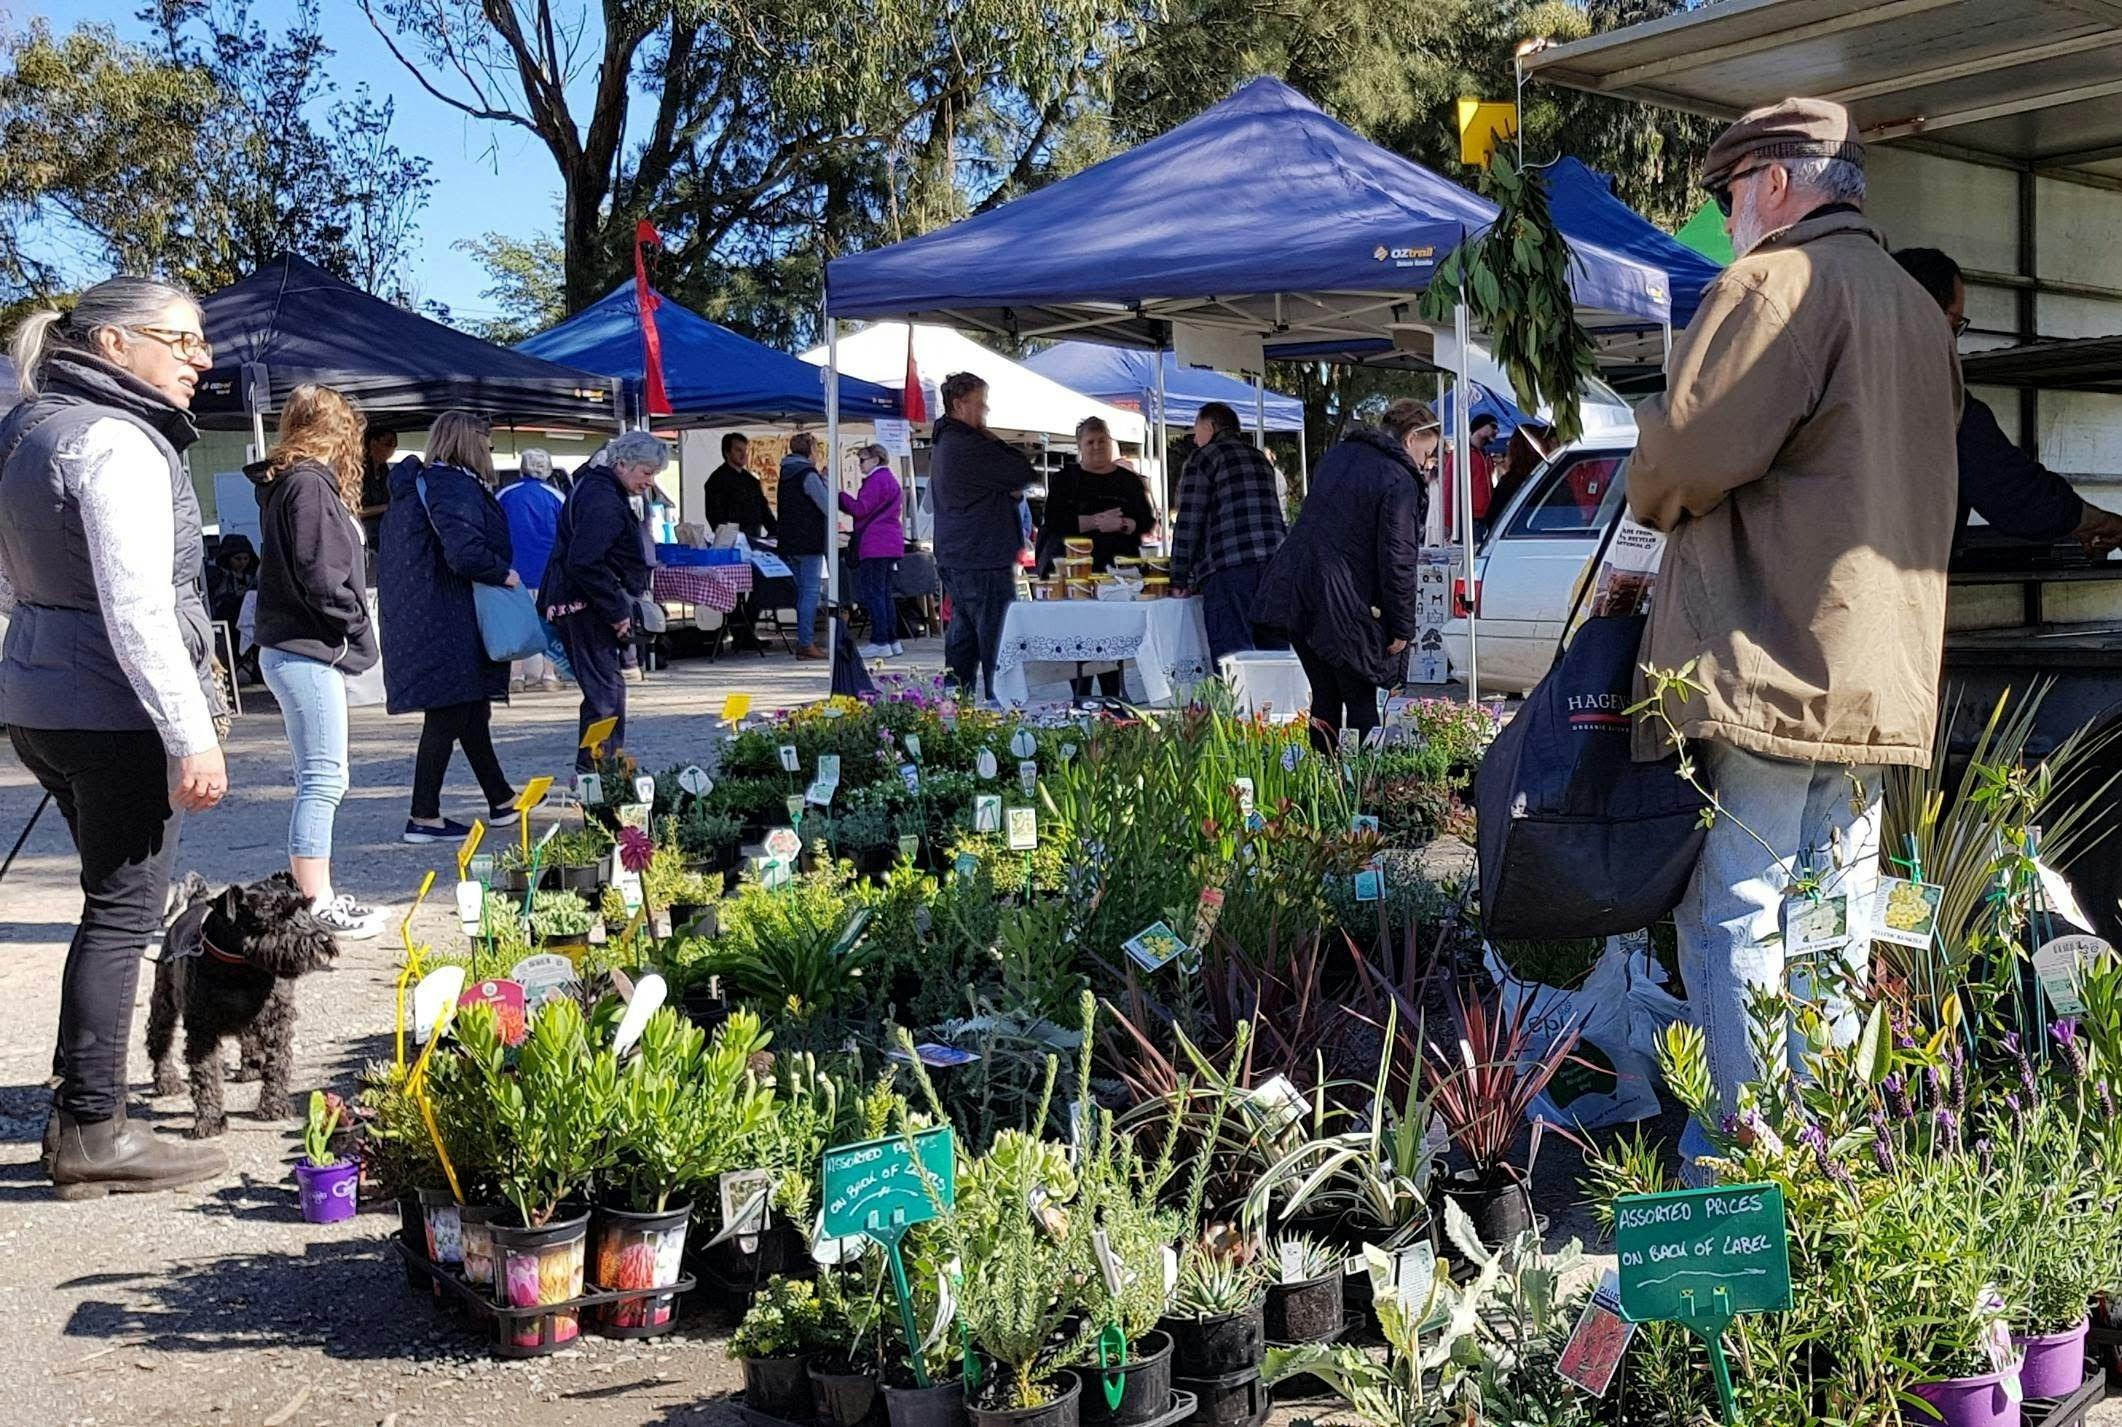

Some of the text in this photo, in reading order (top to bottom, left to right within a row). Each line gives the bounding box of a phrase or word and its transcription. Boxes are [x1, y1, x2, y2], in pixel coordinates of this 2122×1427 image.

[1391, 247, 1434, 259] OZtrail
[826, 1148, 883, 1174] ASSORTED
[830, 1196, 848, 1214] ON
[881, 1163, 900, 1179] OF
[1618, 1194, 1763, 1230] ASSORTED PRICES
[1622, 1234, 1772, 1266] ON BACK OF LABEL
[1598, 1284, 1620, 1301] CALLIS
